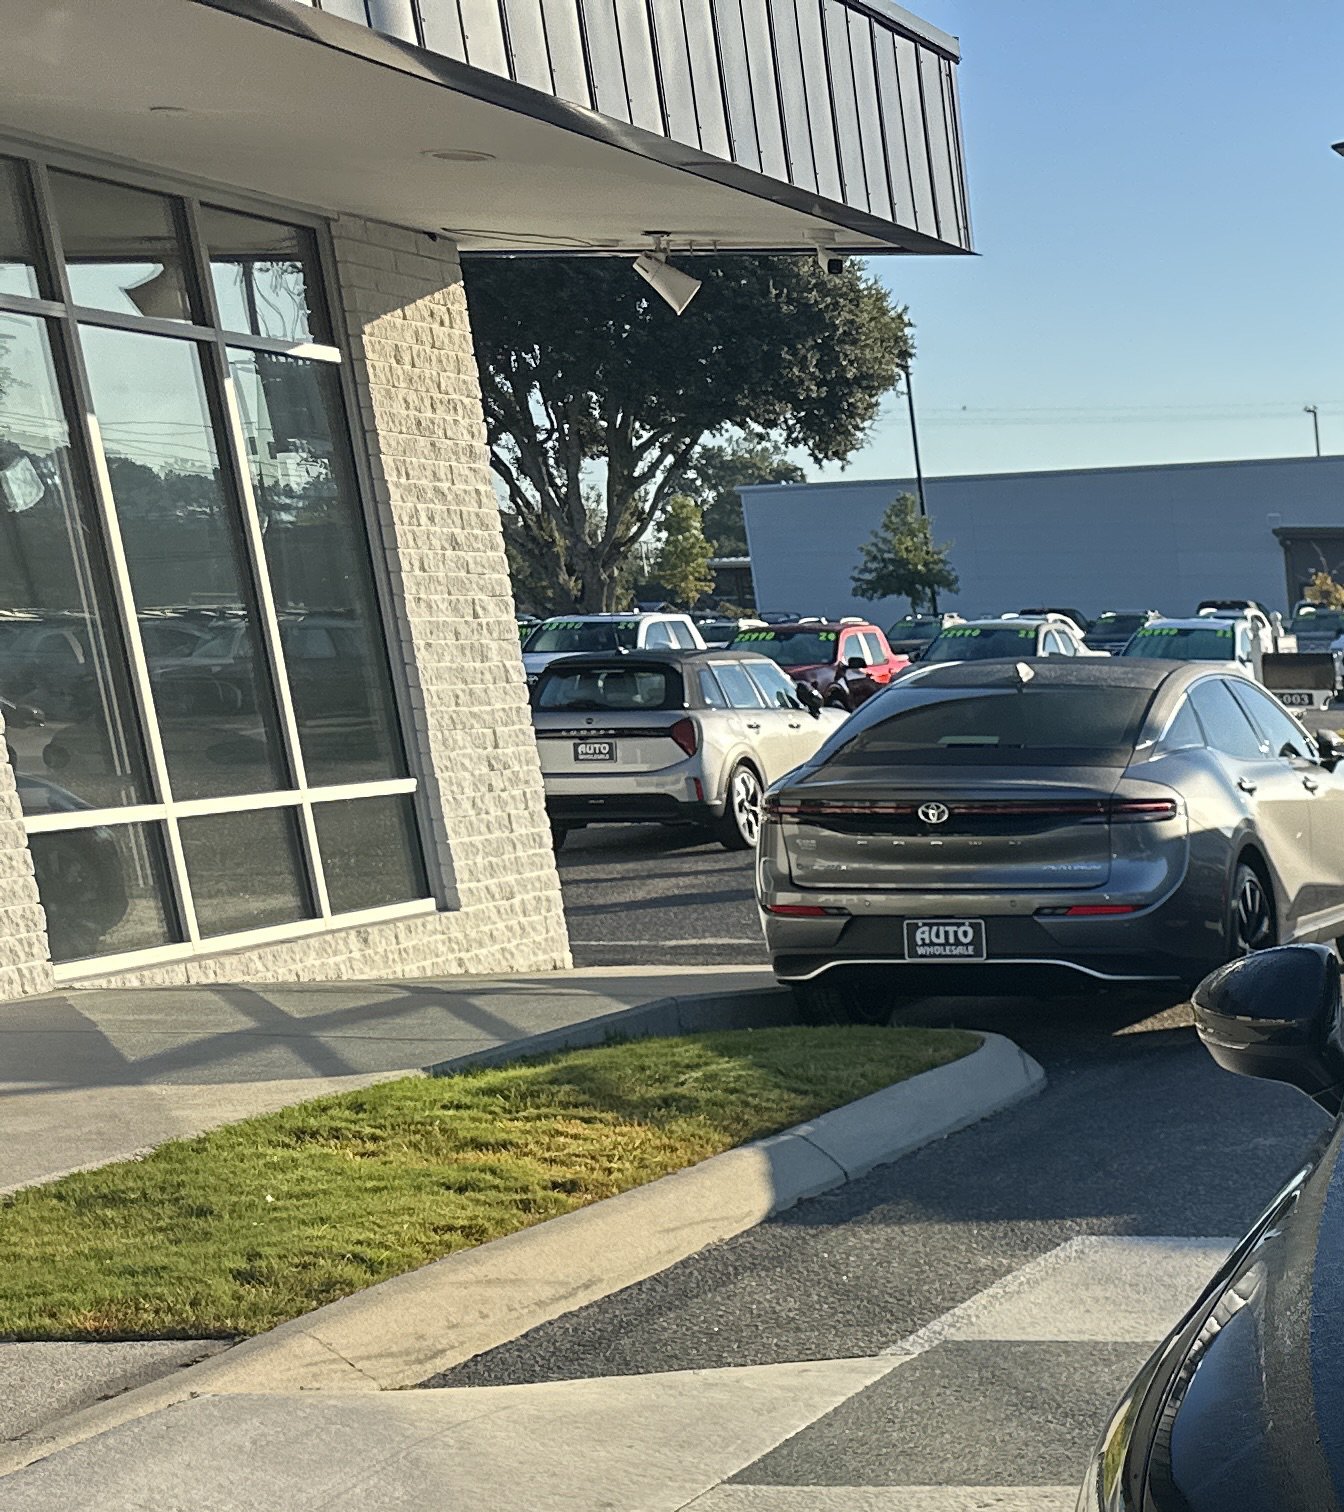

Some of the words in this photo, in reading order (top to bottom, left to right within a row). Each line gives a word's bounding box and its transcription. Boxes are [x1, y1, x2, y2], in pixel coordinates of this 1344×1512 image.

[578, 743, 610, 755] AUTO
[915, 926, 974, 945] AUTO
[916, 945, 975, 956] WHOLESALE
